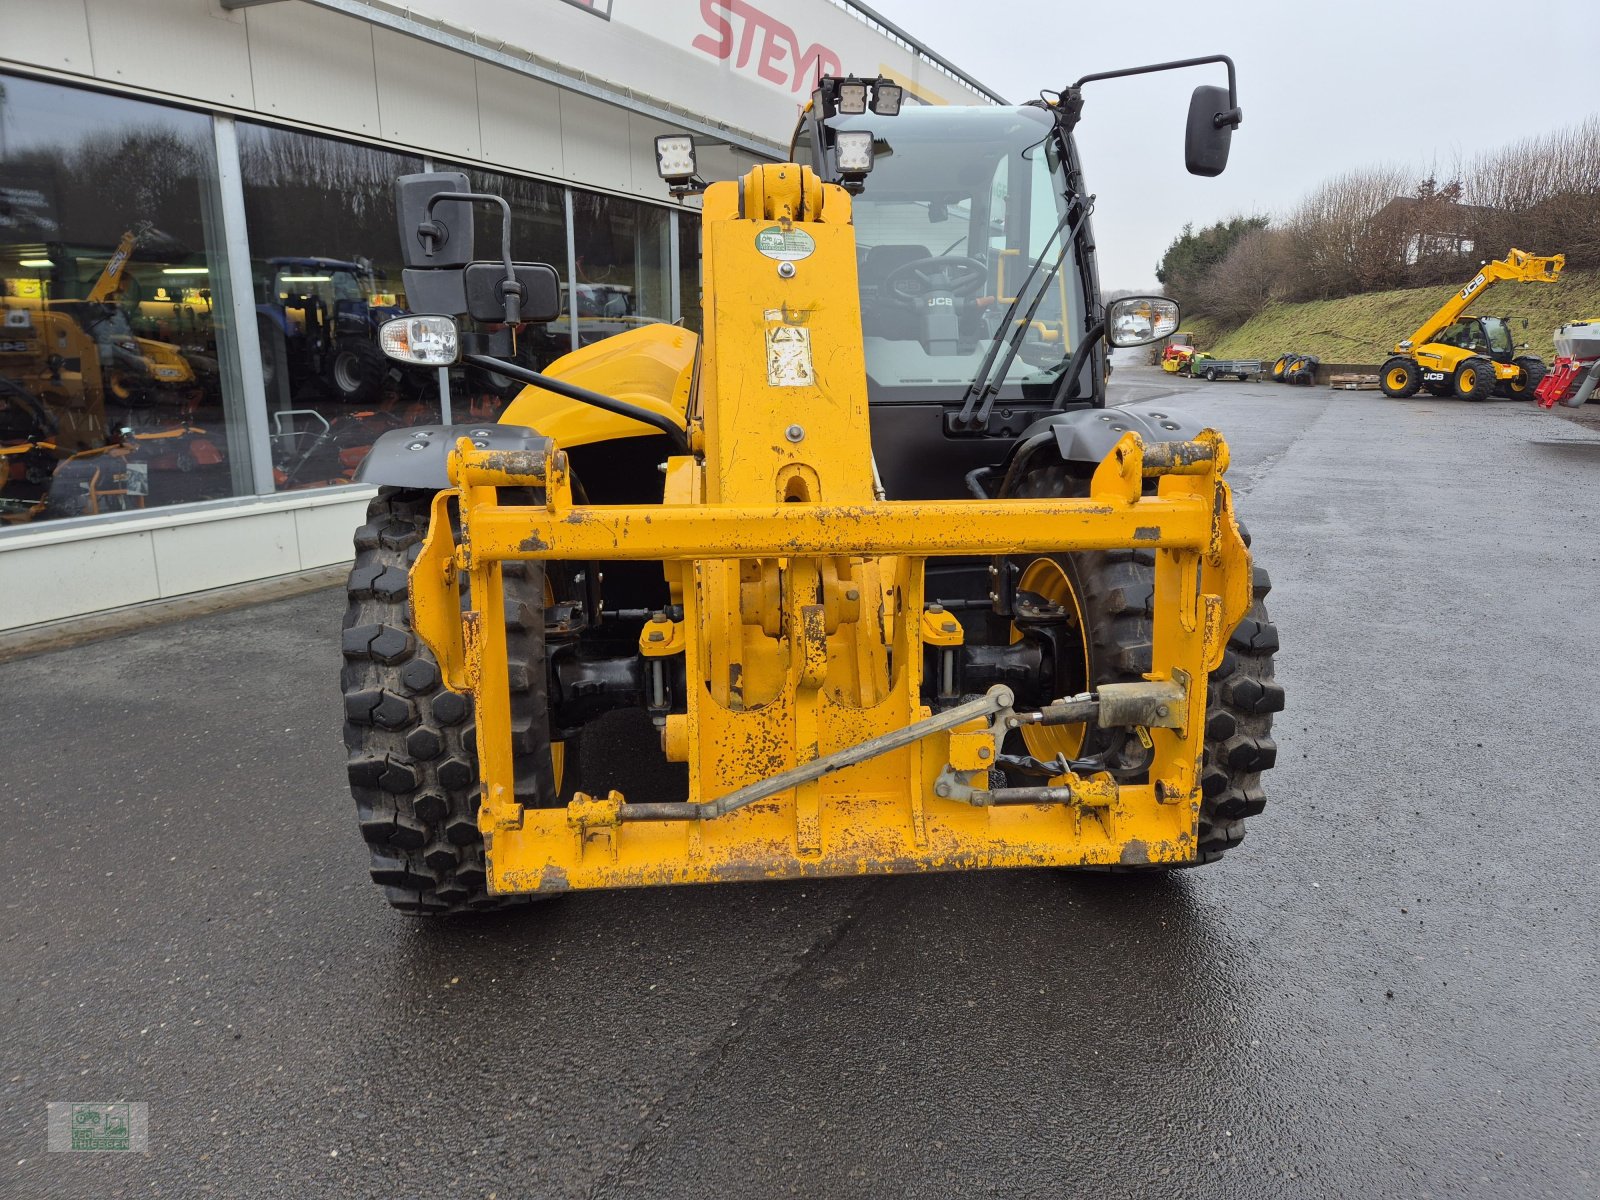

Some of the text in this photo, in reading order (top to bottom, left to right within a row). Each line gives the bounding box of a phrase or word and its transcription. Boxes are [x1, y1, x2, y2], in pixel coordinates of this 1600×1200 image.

[1461, 273, 1486, 300] JCB
[928, 297, 953, 307] JCB
[1423, 372, 1444, 381] JCB
